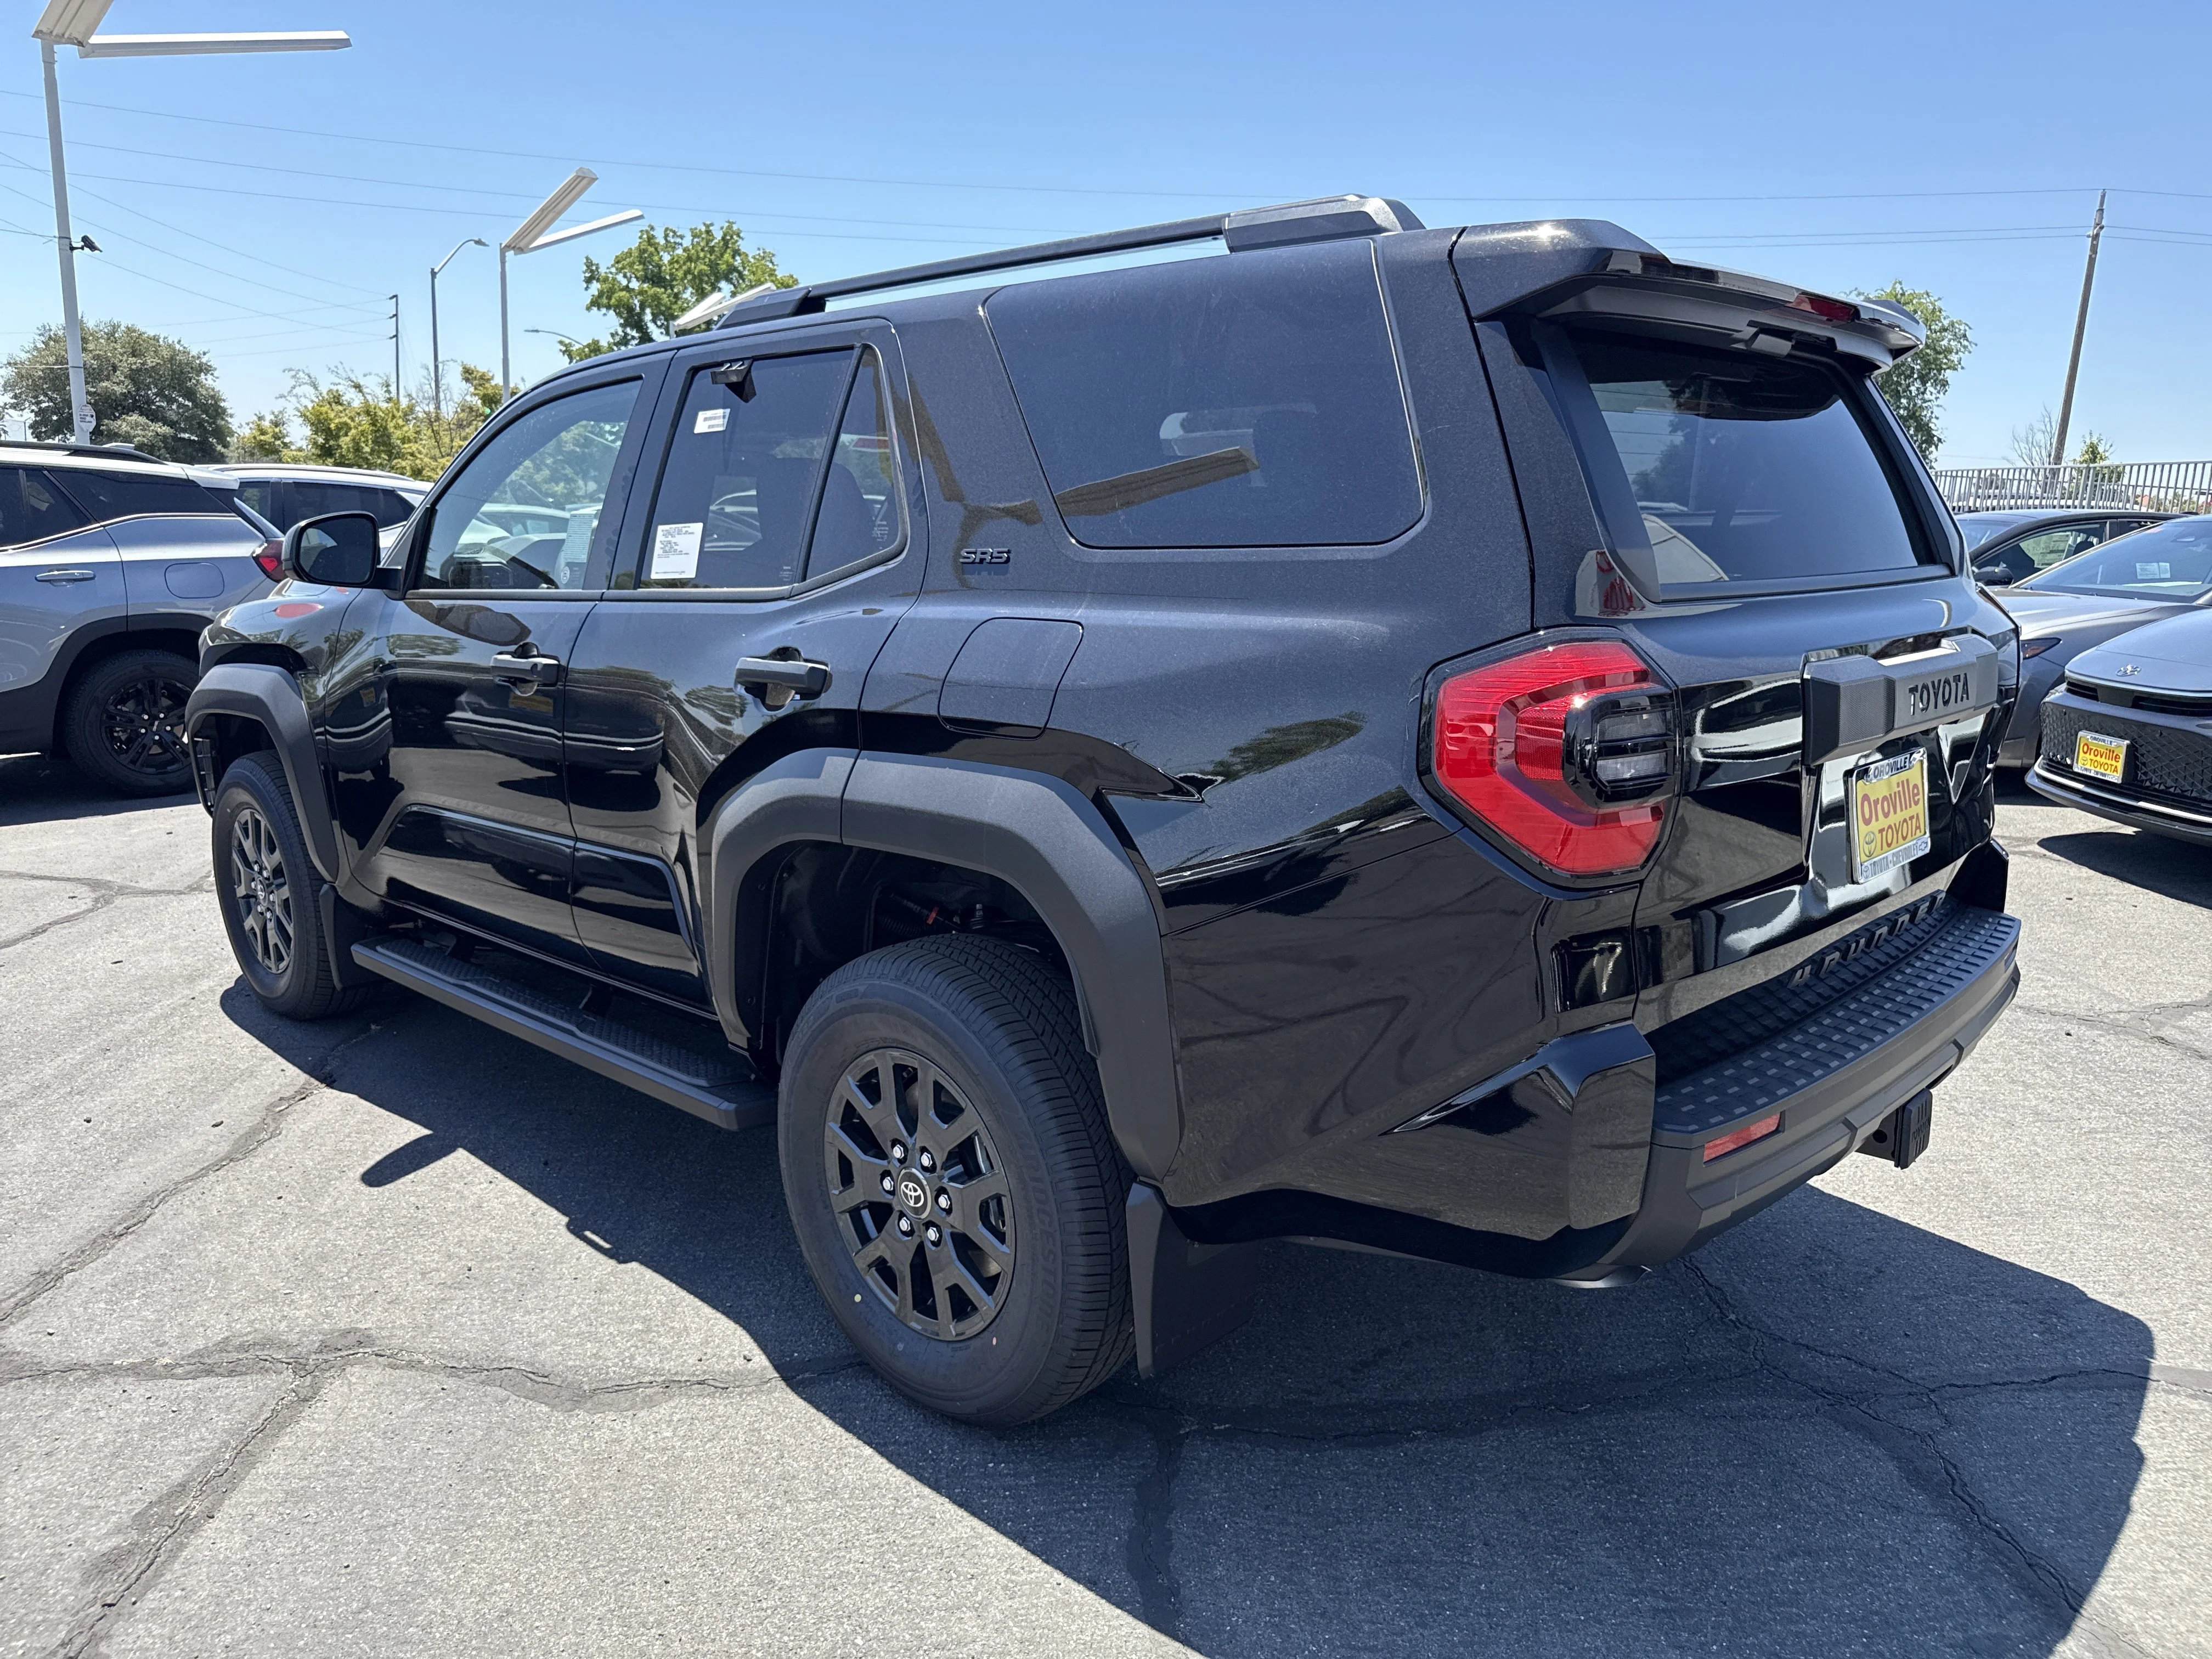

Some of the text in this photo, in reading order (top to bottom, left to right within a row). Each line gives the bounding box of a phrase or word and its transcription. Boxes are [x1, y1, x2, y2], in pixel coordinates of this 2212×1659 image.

[960, 549, 1009, 564] SR5
[1908, 673, 1970, 715] TOYOTA
[2082, 743, 2121, 763] Oroville
[1873, 756, 1908, 779] OROVILLE
[2089, 758, 2119, 775] TOYOTA
[1860, 778, 1920, 826] Oroville
[1878, 812, 1922, 851] TOYOTA
[1870, 856, 1889, 878] TOYOTA
